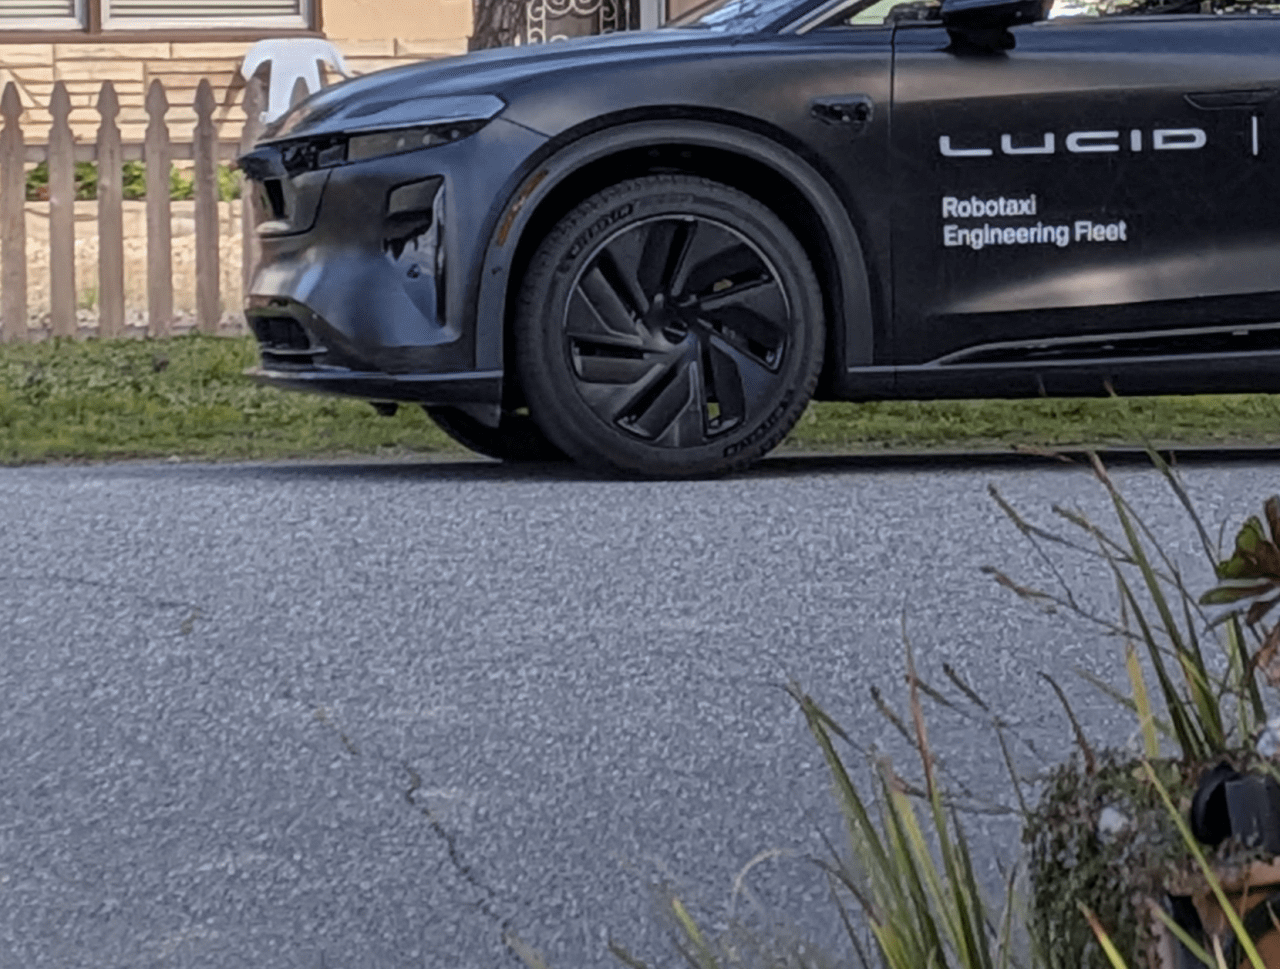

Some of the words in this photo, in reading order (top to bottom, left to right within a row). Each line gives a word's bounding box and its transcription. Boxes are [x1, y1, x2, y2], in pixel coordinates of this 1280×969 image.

[939, 129, 1207, 156] LUCID
[942, 193, 1037, 219] Robotaxi
[943, 221, 1070, 250] Engineering
[1074, 220, 1127, 242] Fleet
